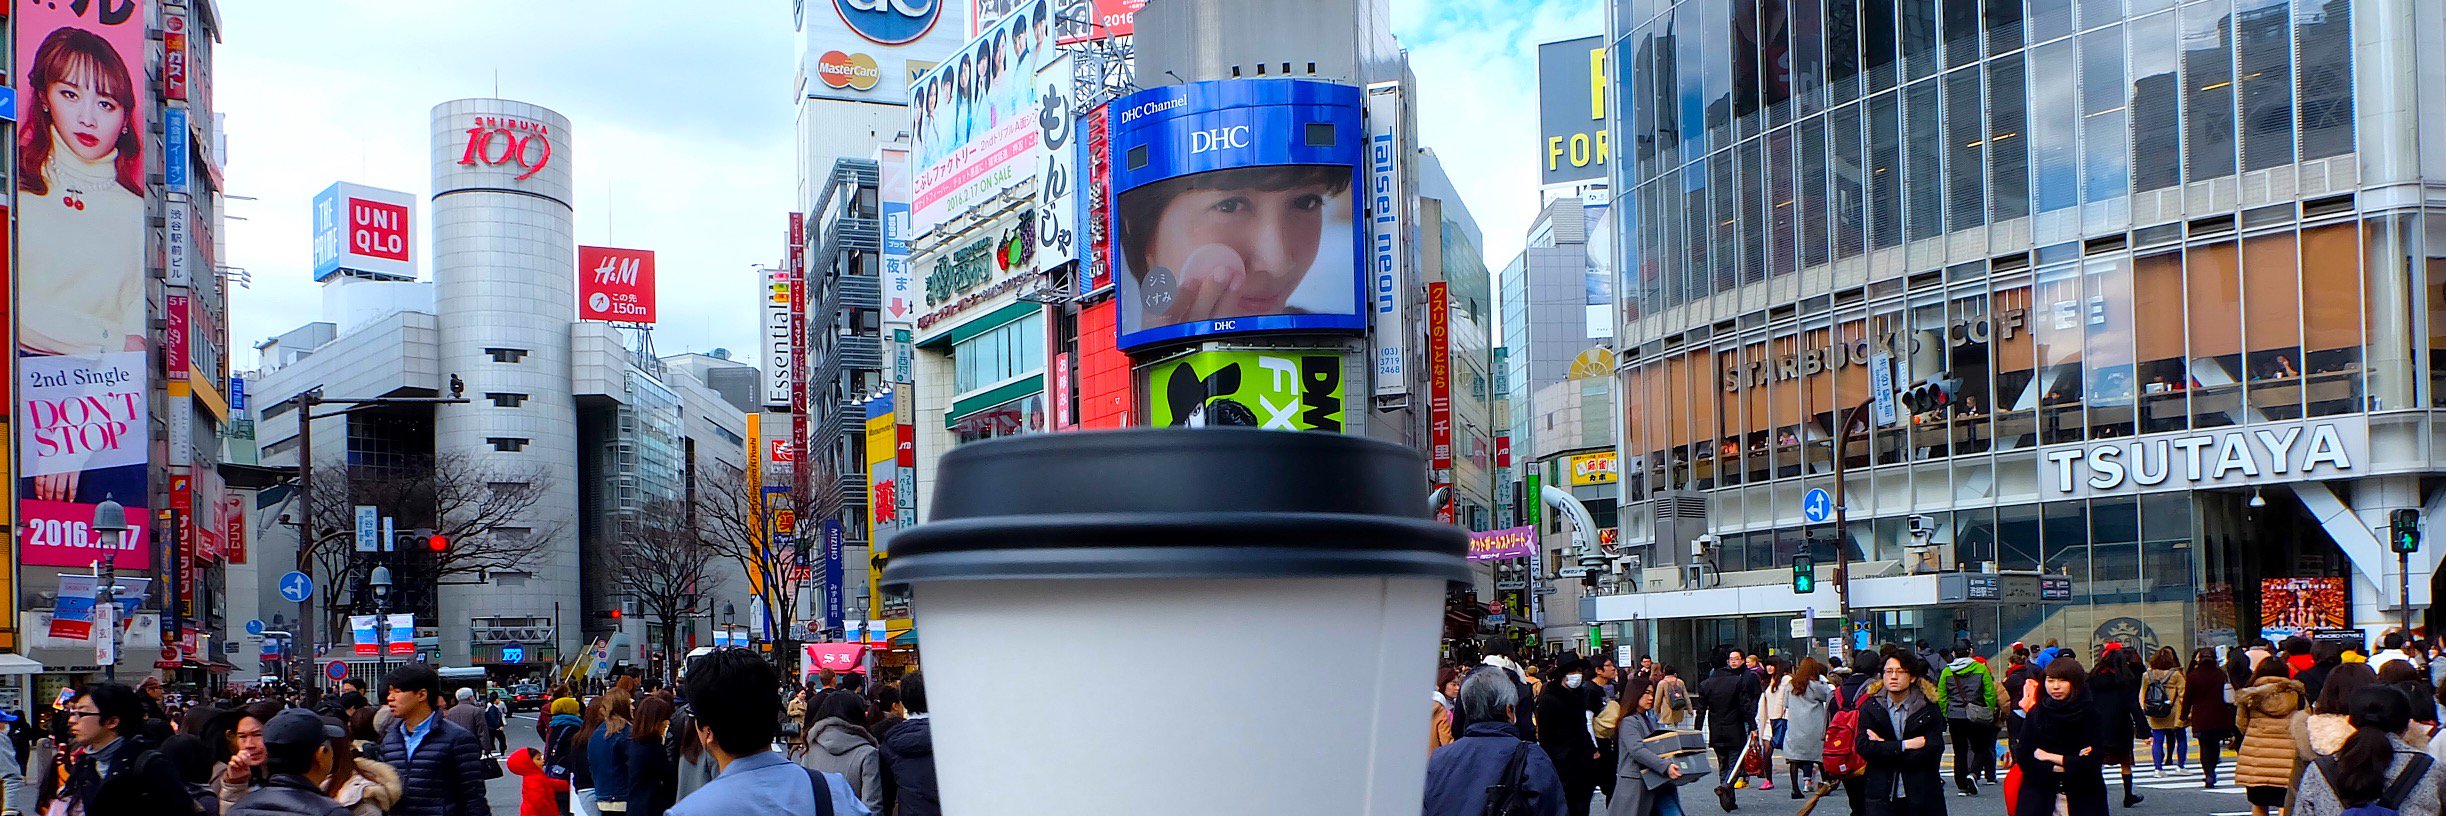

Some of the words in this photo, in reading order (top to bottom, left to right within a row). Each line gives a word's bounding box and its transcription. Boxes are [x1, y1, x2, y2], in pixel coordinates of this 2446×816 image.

[168, 52, 183, 90] ガスト
[819, 62, 878, 77] MasterCard
[475, 116, 548, 135] SHIBUYA
[1121, 107, 1143, 124] DHC
[1143, 95, 1188, 115] Channel
[457, 126, 551, 181] 109
[1190, 125, 1250, 154] DHC
[914, 147, 977, 194] こぶしファクトリー
[1039, 84, 1072, 257] もんじゃ
[1374, 125, 1394, 224] Taisei
[946, 183, 979, 213] 2016.2.17
[980, 175, 993, 193] ON
[994, 165, 1012, 186] SALE
[318, 196, 334, 233] THE
[355, 205, 398, 231] UNI
[170, 209, 182, 280] 渋谷駅前ビル
[314, 226, 338, 269] PRIME
[355, 229, 402, 254] QLO
[593, 255, 641, 287] H&M
[1149, 274, 1167, 287] シミ
[1378, 232, 1394, 313] neon
[169, 297, 188, 306] 5F
[612, 293, 637, 303] この先
[612, 302, 647, 316] 150m
[1145, 291, 1172, 305] くすみ
[1214, 320, 1236, 331] DHC
[1432, 287, 1446, 389] クスリのことなら
[769, 303, 790, 402] Essential
[1380, 347, 1399, 356] (03)
[1725, 328, 1921, 393] STARBUCKS
[1951, 294, 2104, 348] COFFEE
[30, 370, 68, 388] 2nd
[74, 366, 130, 388] Single
[1379, 357, 1400, 366] 3719
[1379, 366, 1401, 375] 2468
[1259, 355, 1299, 431] FX
[28, 391, 141, 430] DON'T
[34, 421, 128, 457] STOP
[1433, 397, 1450, 461] 三千里
[2047, 423, 2352, 493] TSUTAYA
[230, 522, 241, 549] アコム
[502, 652, 523, 664] 109
